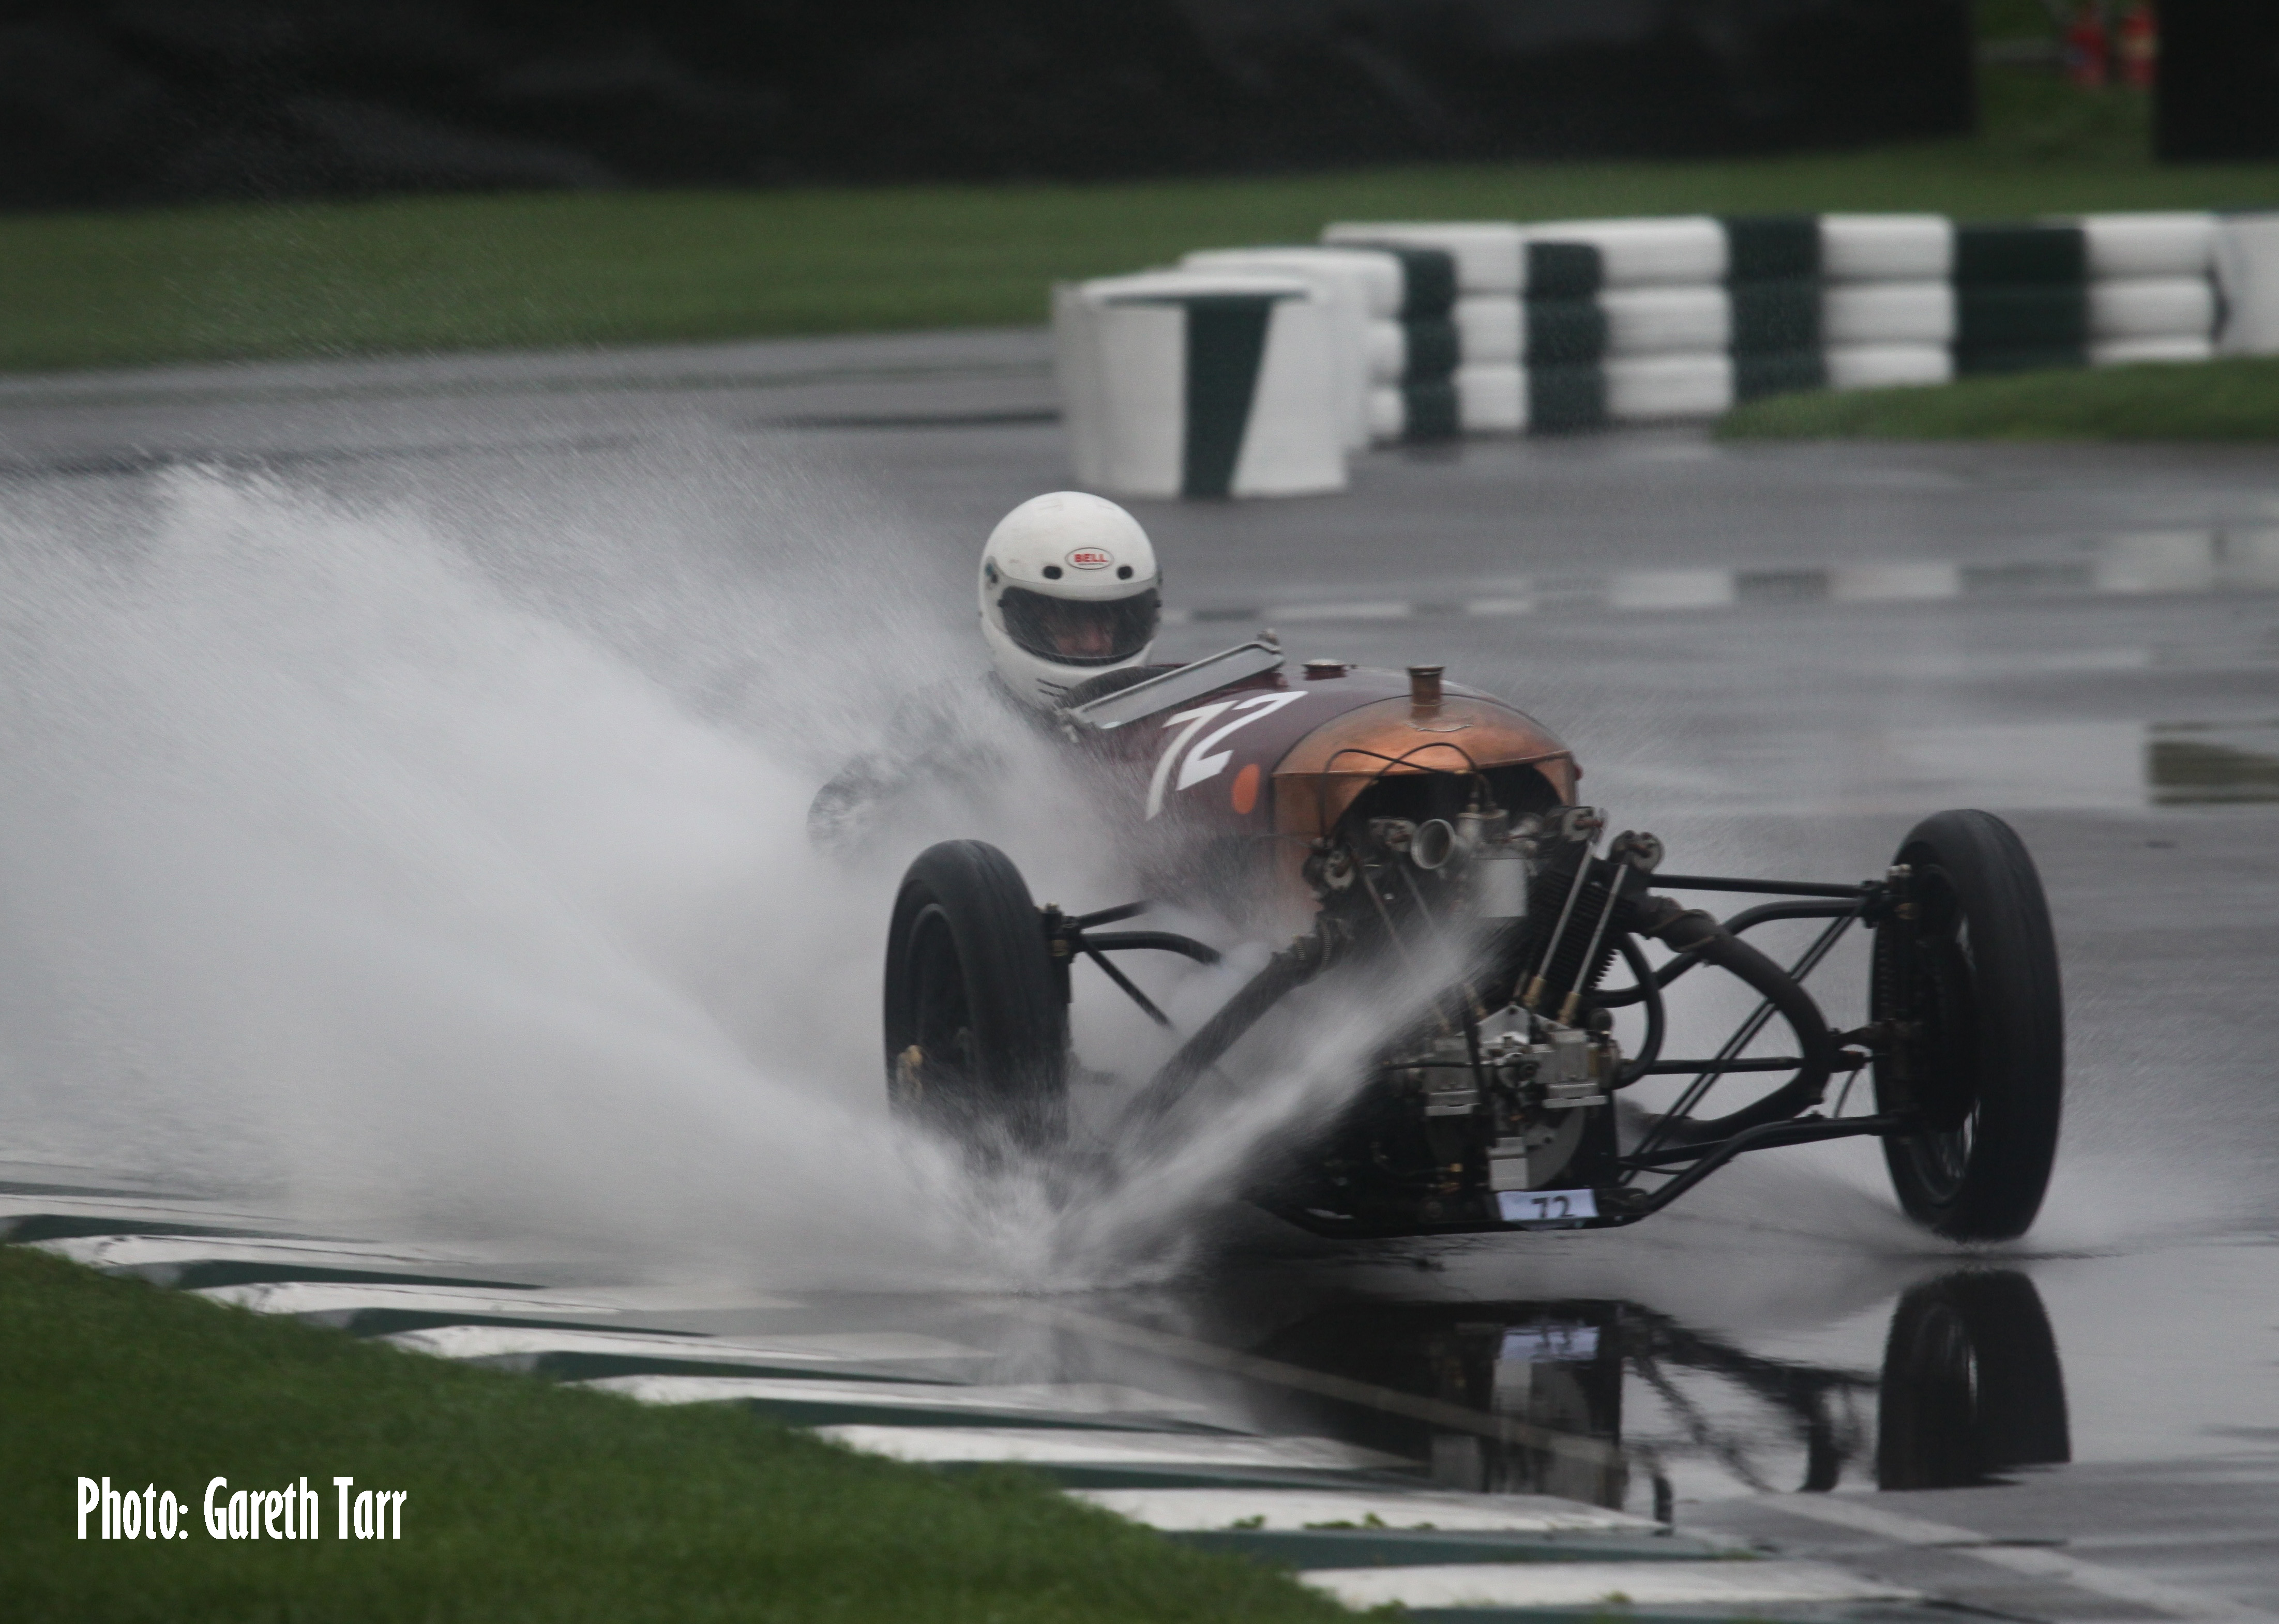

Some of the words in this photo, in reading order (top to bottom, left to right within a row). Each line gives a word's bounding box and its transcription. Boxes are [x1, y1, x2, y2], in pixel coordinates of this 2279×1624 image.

[1074, 553, 1108, 563] BELL
[1145, 691, 1309, 822] 72
[1531, 1195, 1576, 1218] 72
